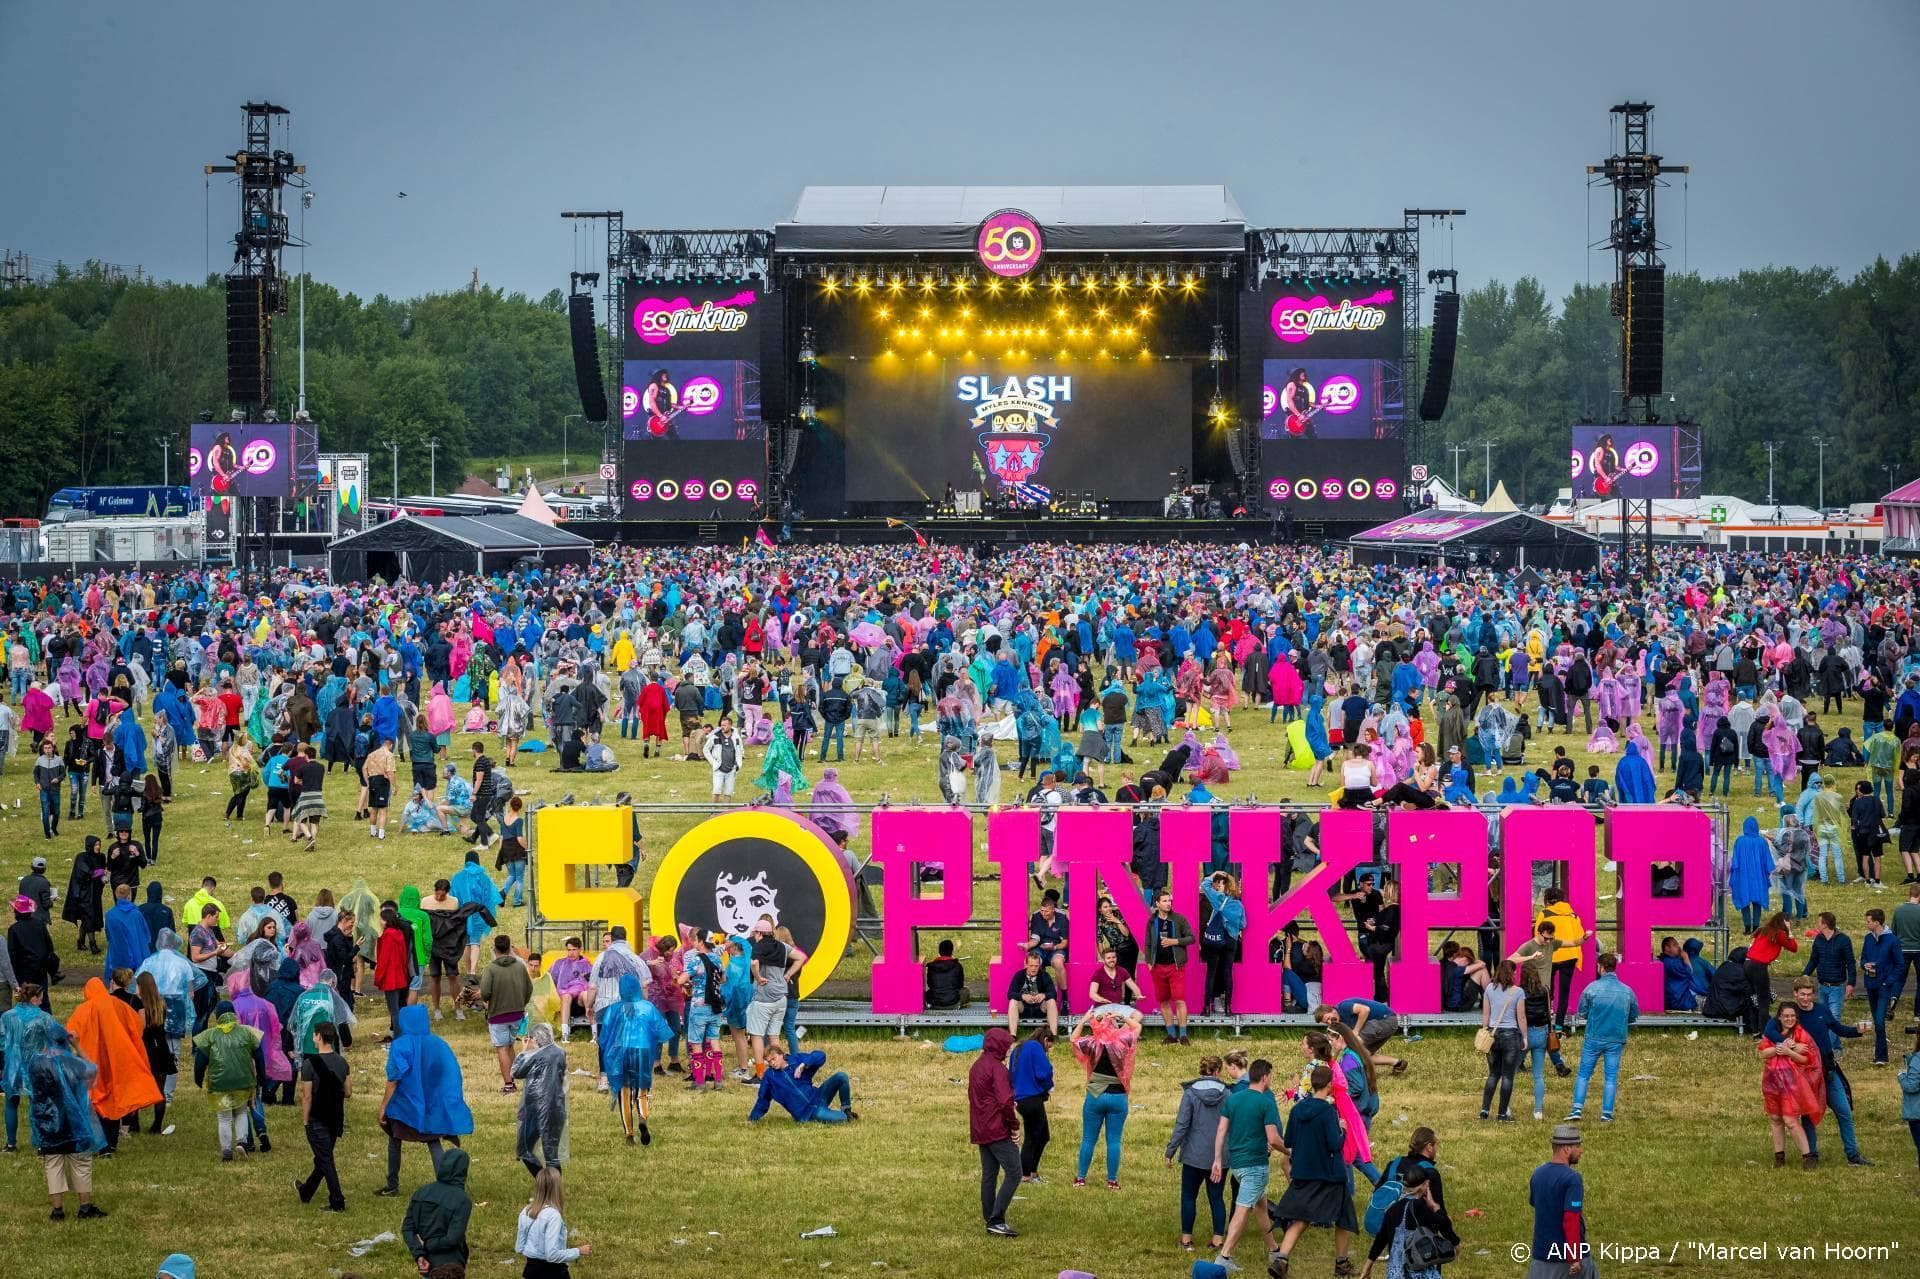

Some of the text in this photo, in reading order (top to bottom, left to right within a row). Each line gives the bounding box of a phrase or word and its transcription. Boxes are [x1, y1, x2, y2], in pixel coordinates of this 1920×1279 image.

[984, 226, 1036, 261] 50
[641, 311, 672, 331] 50
[1279, 310, 1310, 330] 50
[958, 375, 1071, 401] SLASH
[981, 399, 1049, 412] MYLES KENNEDY
[632, 484, 652, 496] 50
[684, 484, 704, 496] 50
[1270, 482, 1290, 495] 50
[1322, 482, 1342, 495] 50
[1375, 482, 1395, 495] 50
[537, 802, 1712, 1016] 50 PINKPOP
